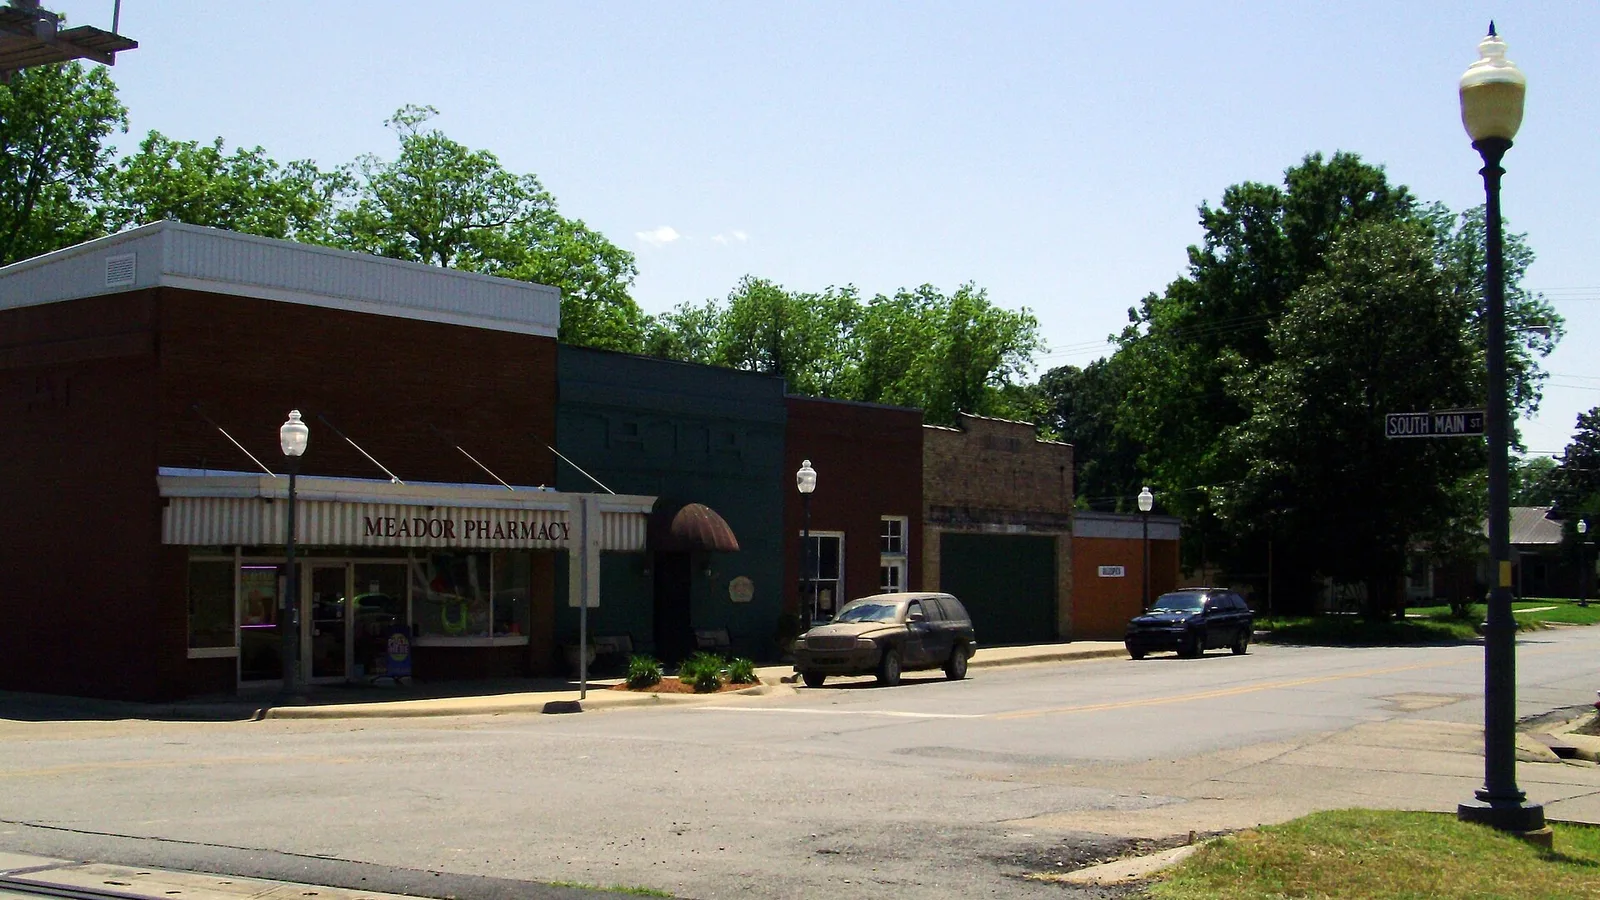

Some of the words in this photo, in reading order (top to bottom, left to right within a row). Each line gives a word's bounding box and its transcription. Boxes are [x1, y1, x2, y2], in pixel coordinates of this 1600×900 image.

[1390, 416, 1429, 434] SOUTH
[1435, 415, 1465, 433] MAIN
[364, 516, 456, 539] MEADOR
[464, 519, 570, 541] PHARMACY
